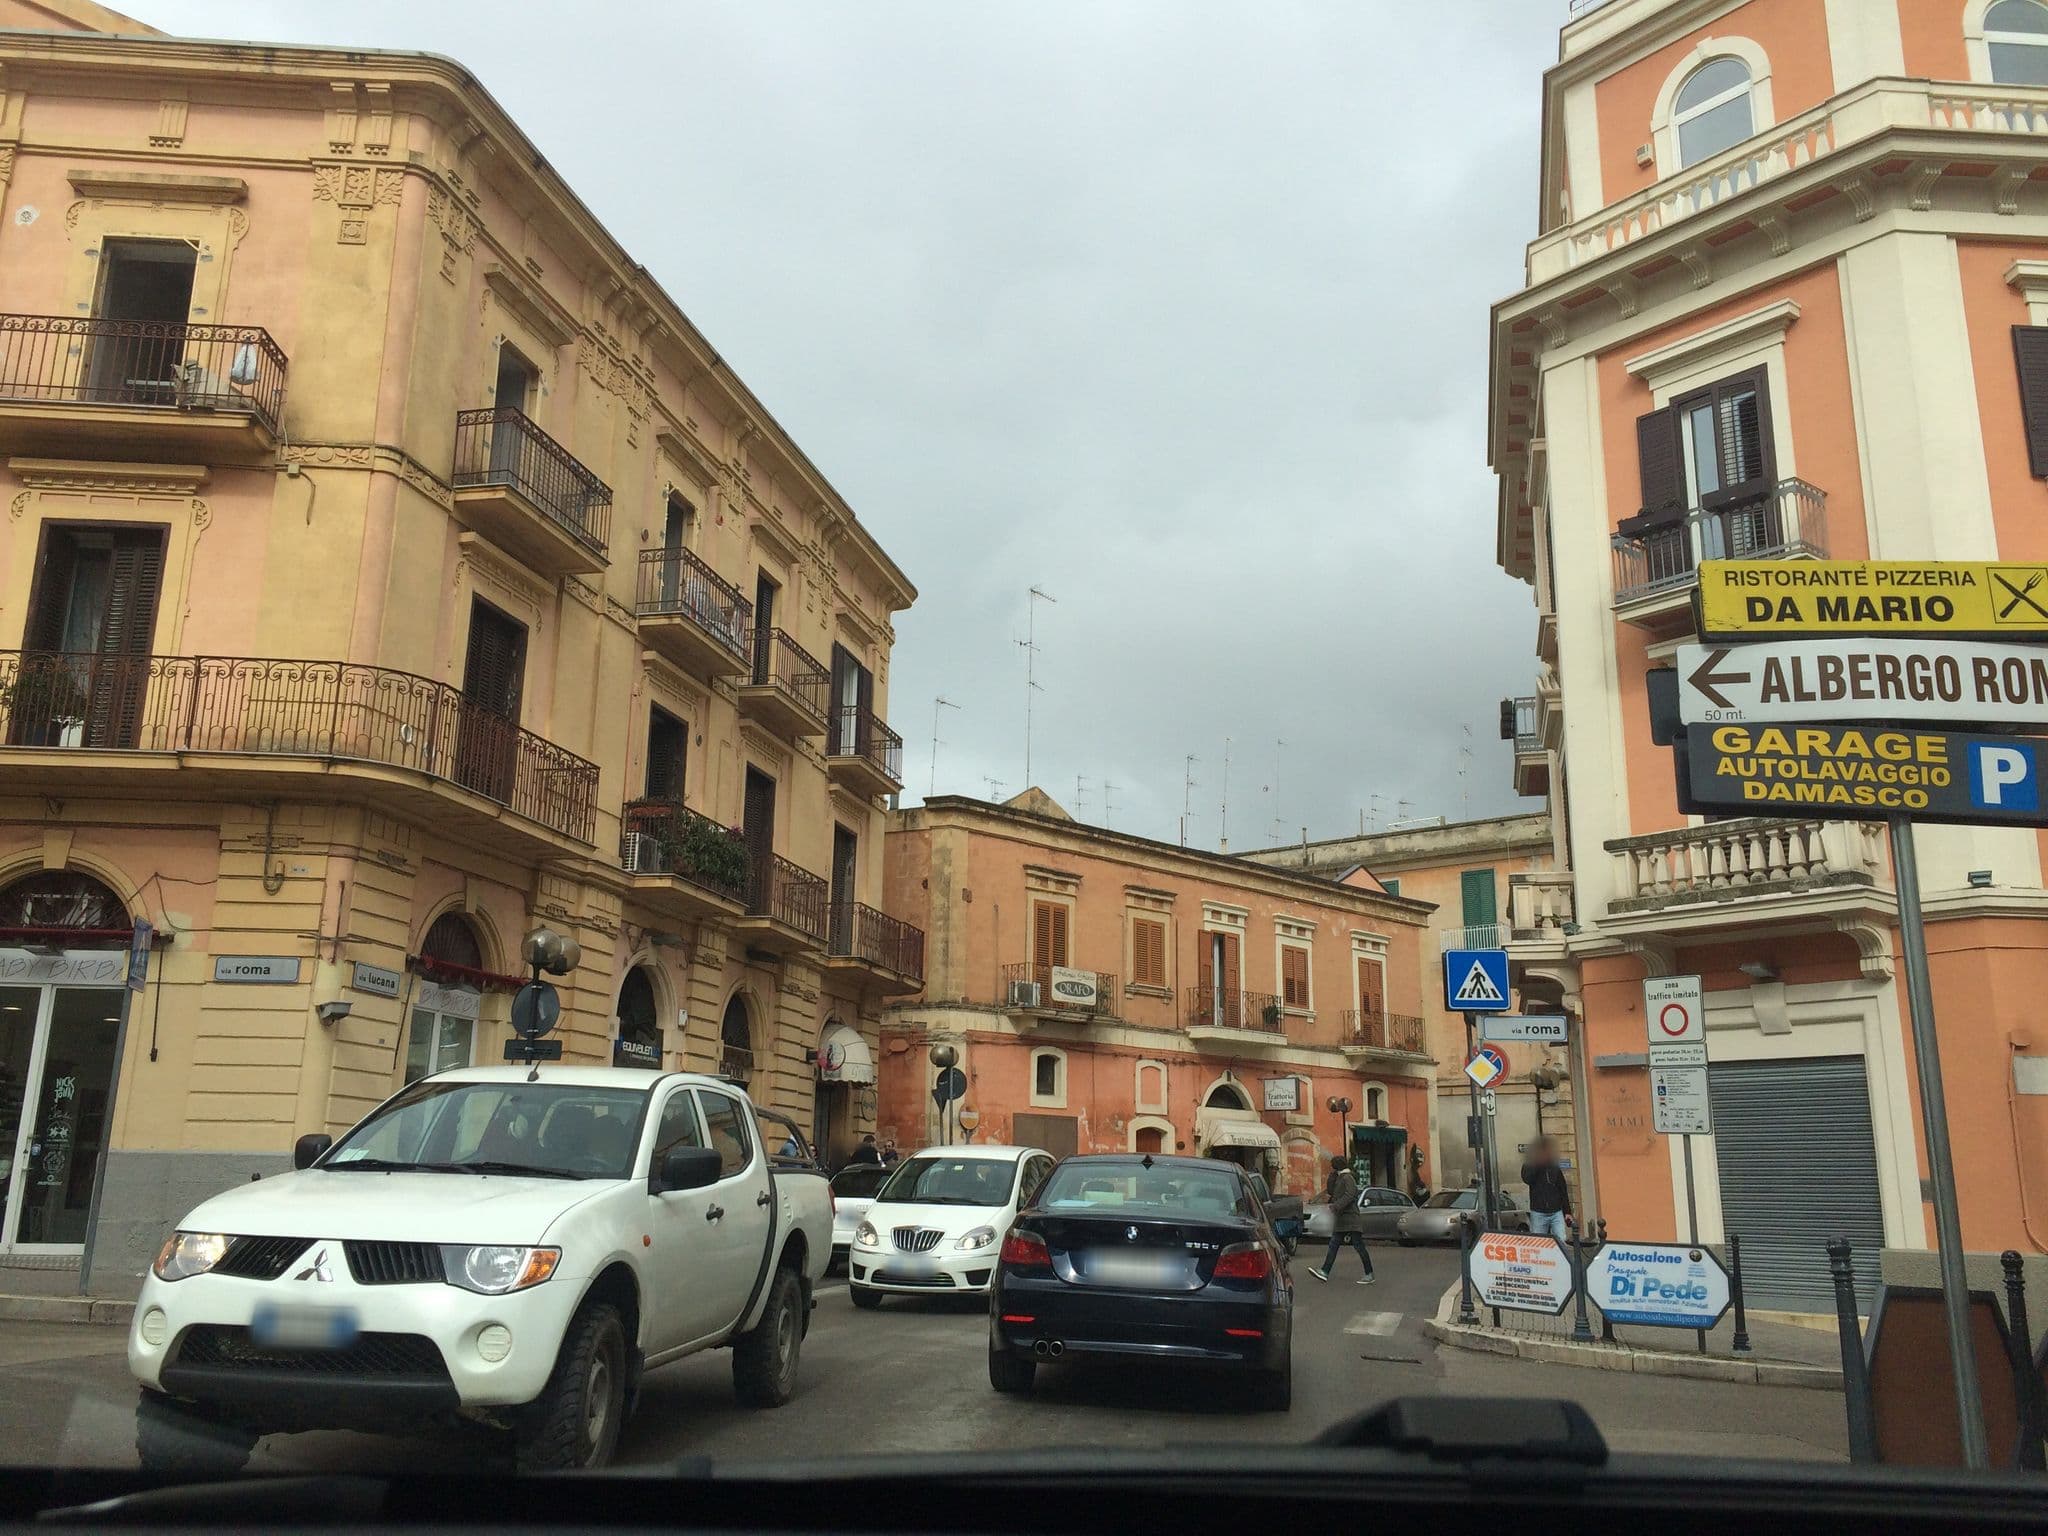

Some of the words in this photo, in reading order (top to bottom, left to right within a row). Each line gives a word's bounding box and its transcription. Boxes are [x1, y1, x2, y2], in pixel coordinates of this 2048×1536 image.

[1724, 569, 1869, 587] RISTORANTE
[1874, 569, 1977, 587] PIZZERIA
[1745, 596, 1804, 623] DA
[1816, 596, 1955, 623] MARIO
[1760, 653, 1962, 704] ALBERGO
[1704, 710, 1722, 721] 50
[1725, 709, 1747, 720] mt.
[1711, 726, 1949, 764] GARAGE
[1716, 756, 1951, 787] AUTOLAVAGGIO
[1979, 746, 2028, 805] P
[1743, 780, 1929, 809] DAMASCO
[235, 964, 271, 975] roma
[368, 976, 396, 989] lucana
[1647, 992, 1672, 1001] traffico
[1672, 991, 1699, 999] limitato
[1525, 1025, 1561, 1035] roma
[1484, 1244, 1518, 1262] csa
[1608, 1249, 1683, 1264] Autosalone
[1610, 1275, 1636, 1297] Di
[1642, 1277, 1709, 1300] Pede
